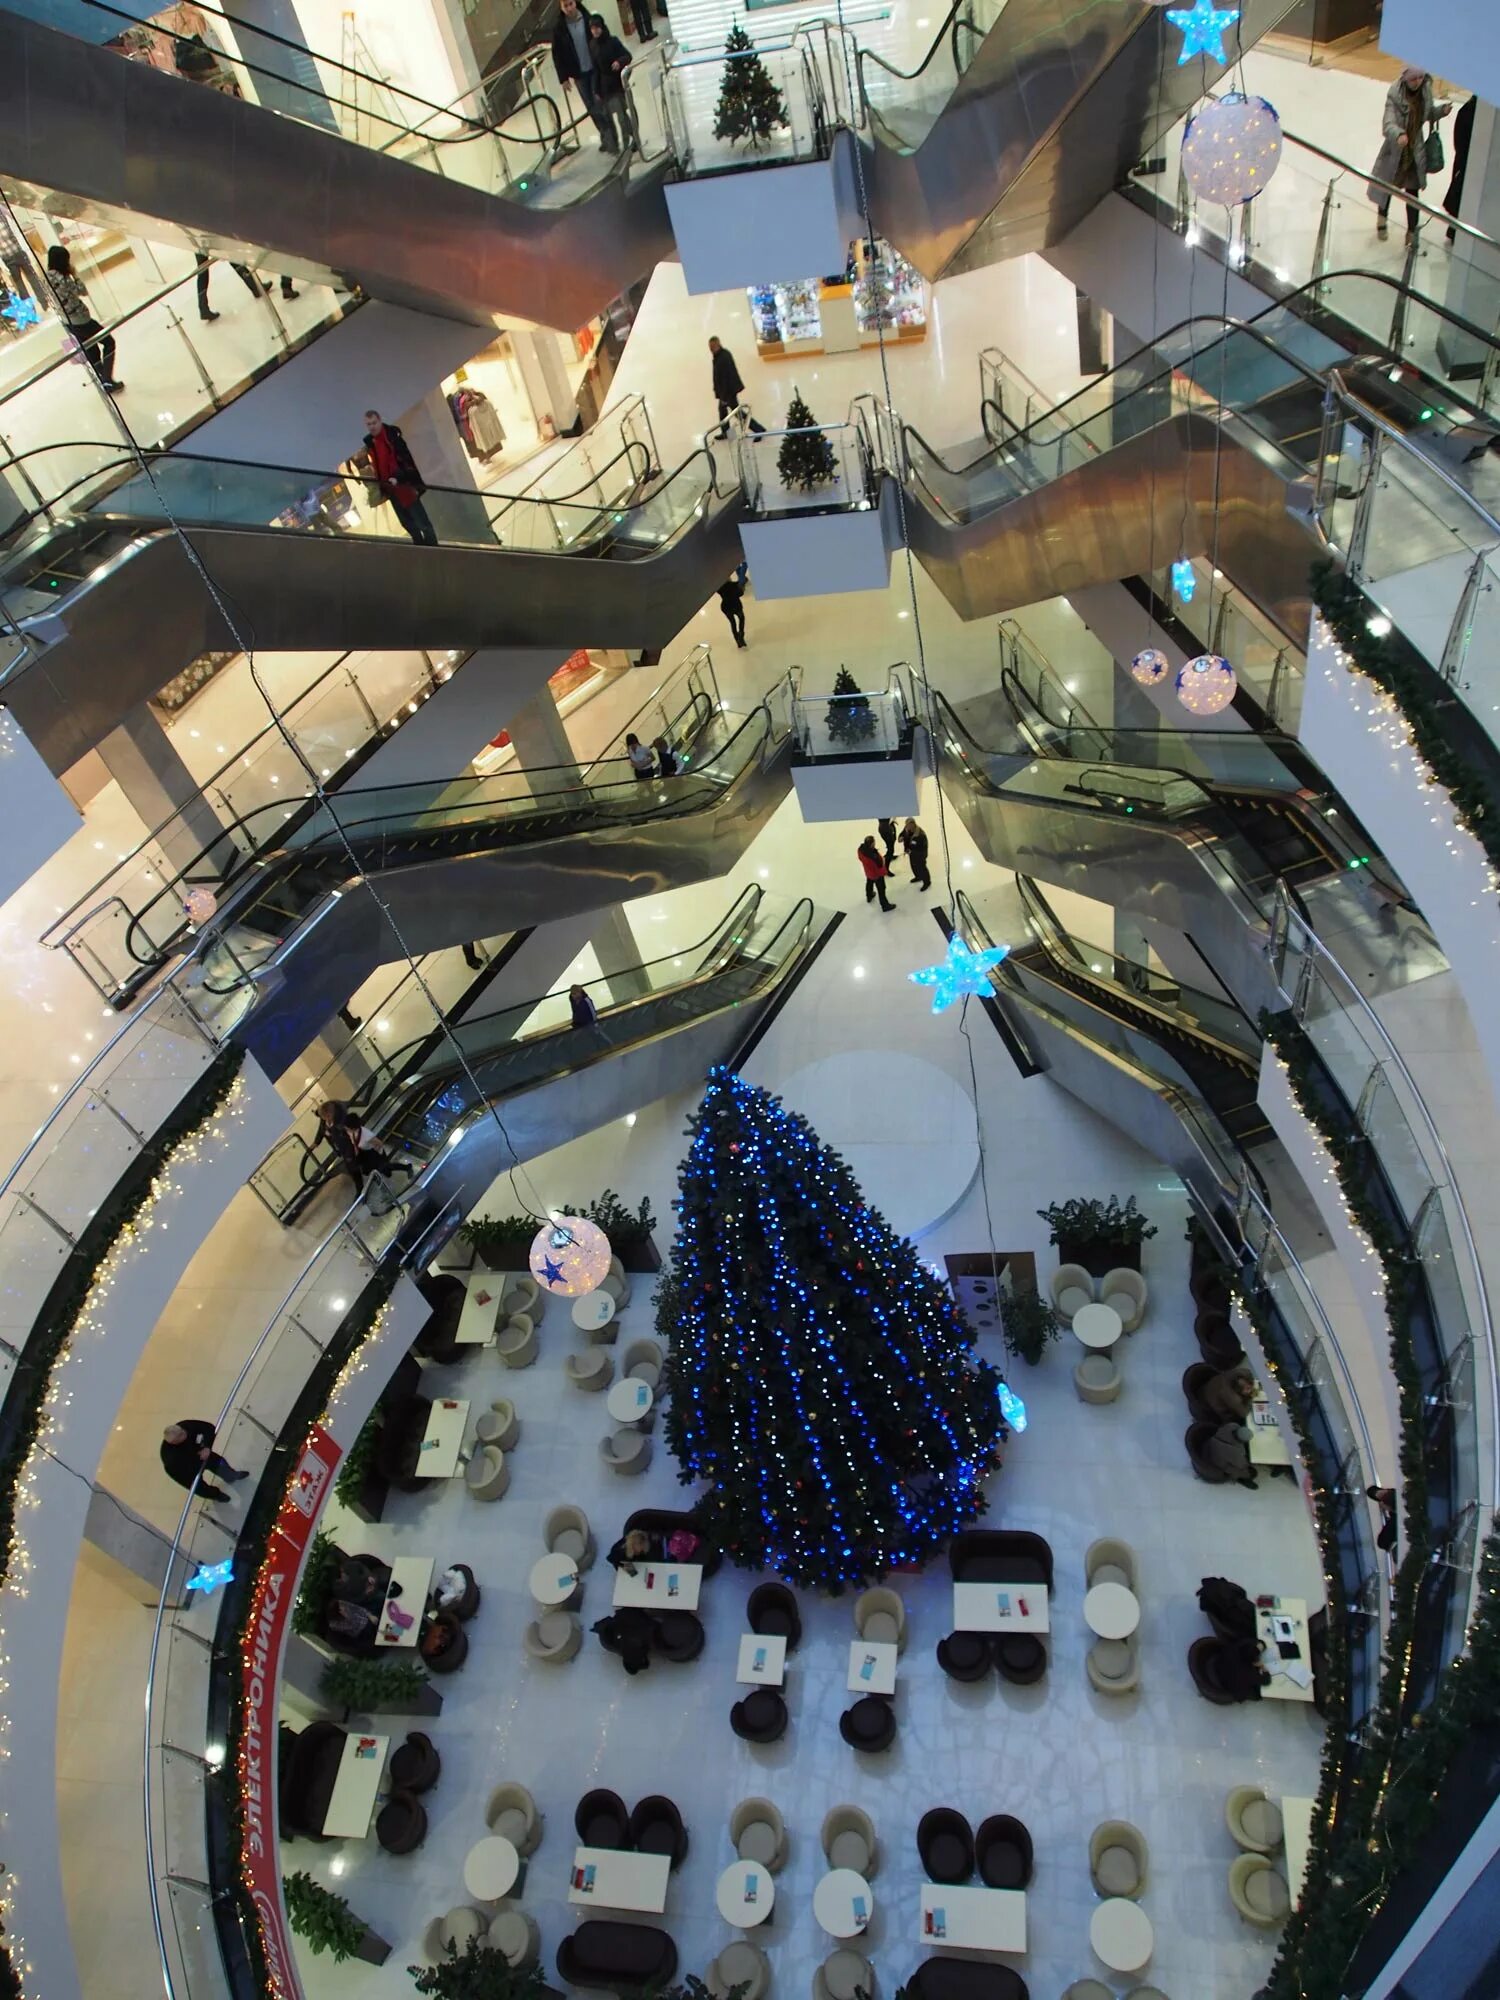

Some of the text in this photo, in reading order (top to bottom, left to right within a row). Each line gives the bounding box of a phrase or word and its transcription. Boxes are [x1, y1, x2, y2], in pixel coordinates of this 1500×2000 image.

[300, 1469, 314, 1493] 4
[304, 1470, 324, 1510] ЭТАЖ
[247, 1573, 286, 1859] ЭЛЕКТРОНИКА
